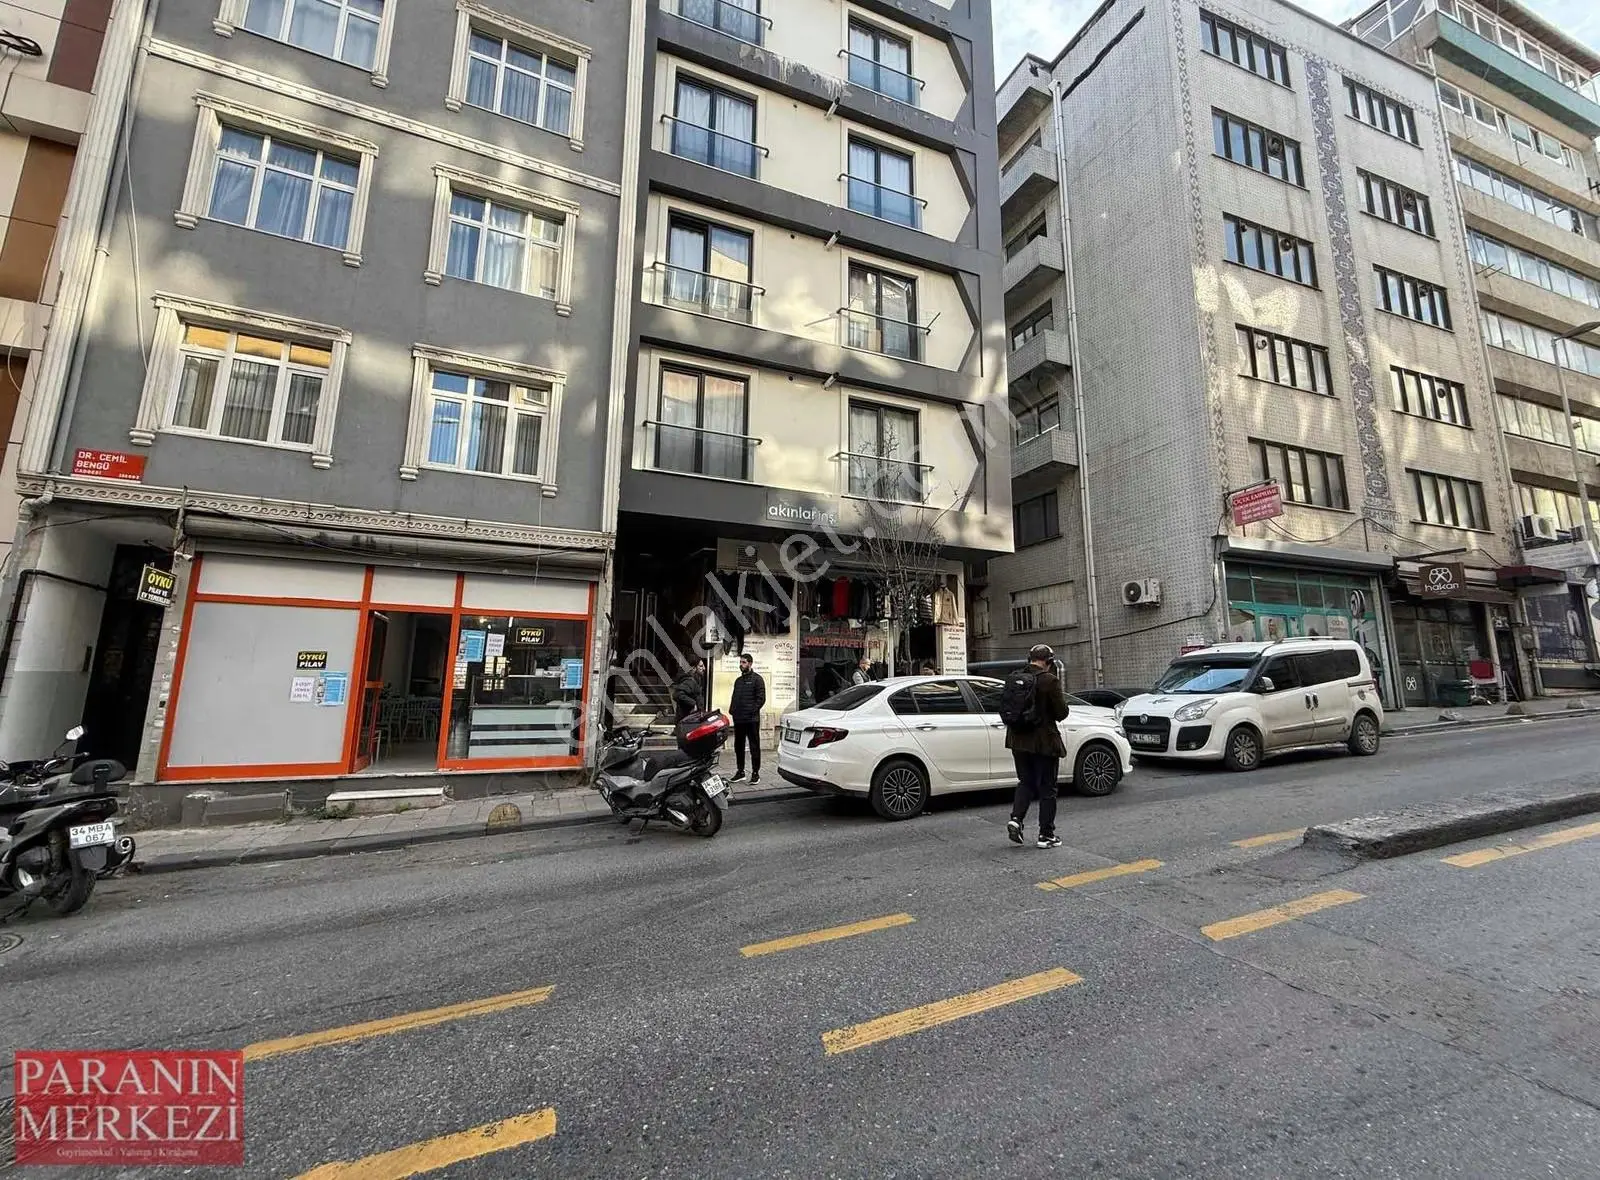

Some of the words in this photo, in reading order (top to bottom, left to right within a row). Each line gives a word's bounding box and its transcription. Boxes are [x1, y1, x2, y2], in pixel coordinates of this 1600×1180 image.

[78, 451, 95, 460] DR.
[99, 453, 127, 464] CEMİL
[76, 460, 110, 470] BENGÜ
[148, 570, 173, 589] ÖYKÜ
[1424, 583, 1459, 592] hakan
[298, 652, 326, 661] ÖYKÜ
[299, 660, 325, 668] PİLAV
[72, 828, 85, 836] 34
[88, 824, 111, 833] MBA
[86, 833, 105, 842] 067
